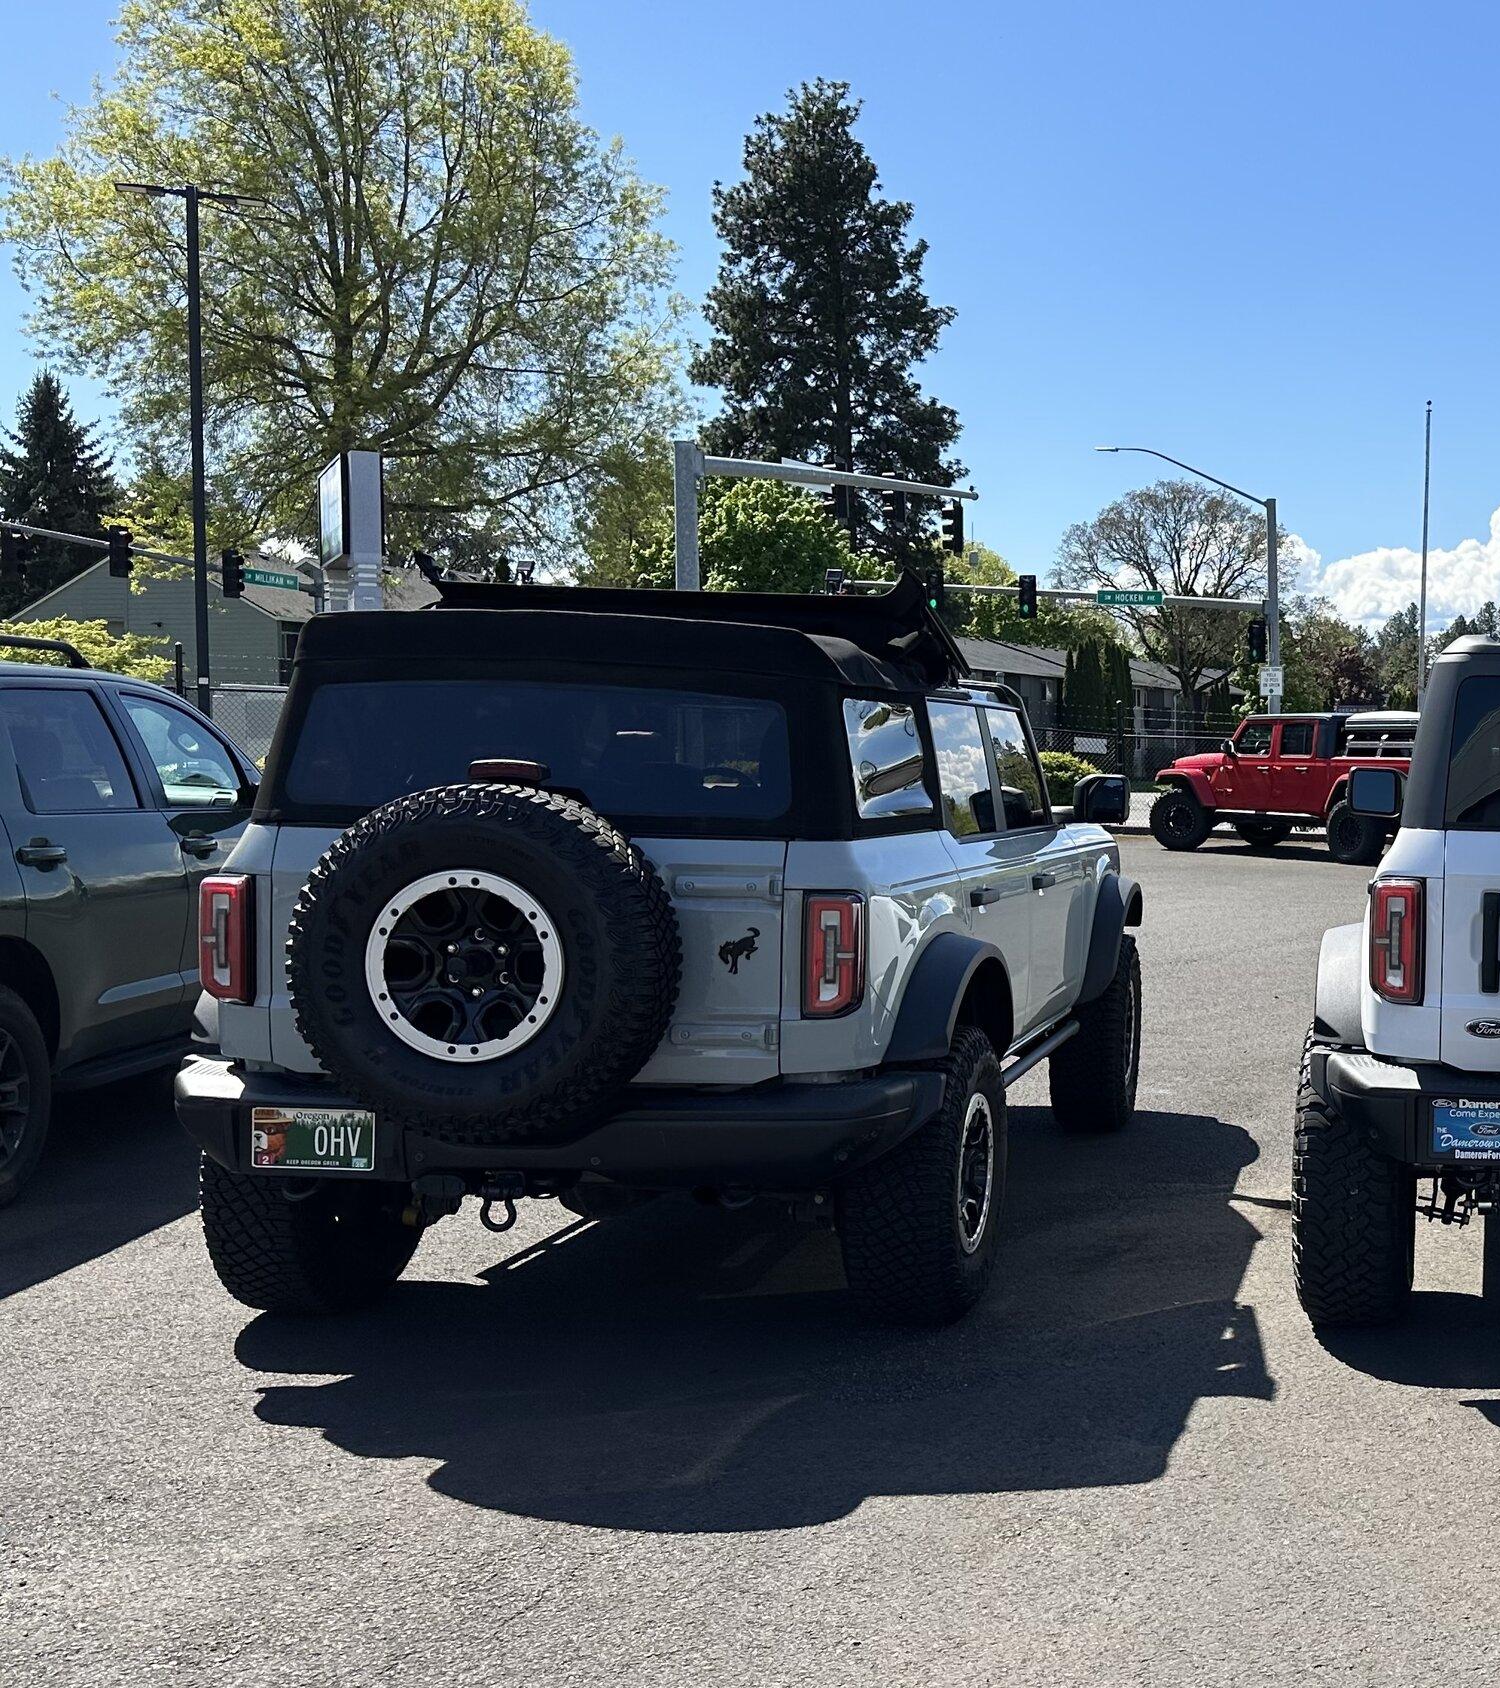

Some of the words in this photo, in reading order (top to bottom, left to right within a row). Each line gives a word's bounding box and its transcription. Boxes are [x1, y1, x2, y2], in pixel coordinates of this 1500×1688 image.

[254, 573, 284, 585] MILLIKAN
[1115, 593, 1143, 602] HOCKEN
[296, 1111, 330, 1121] Oregon
[1449, 1109, 1476, 1118] Come
[1477, 1124, 1499, 1135] Ford
[314, 1125, 361, 1157] OHV
[1440, 1134, 1494, 1147] Damerow
[262, 1156, 269, 1165] 2
